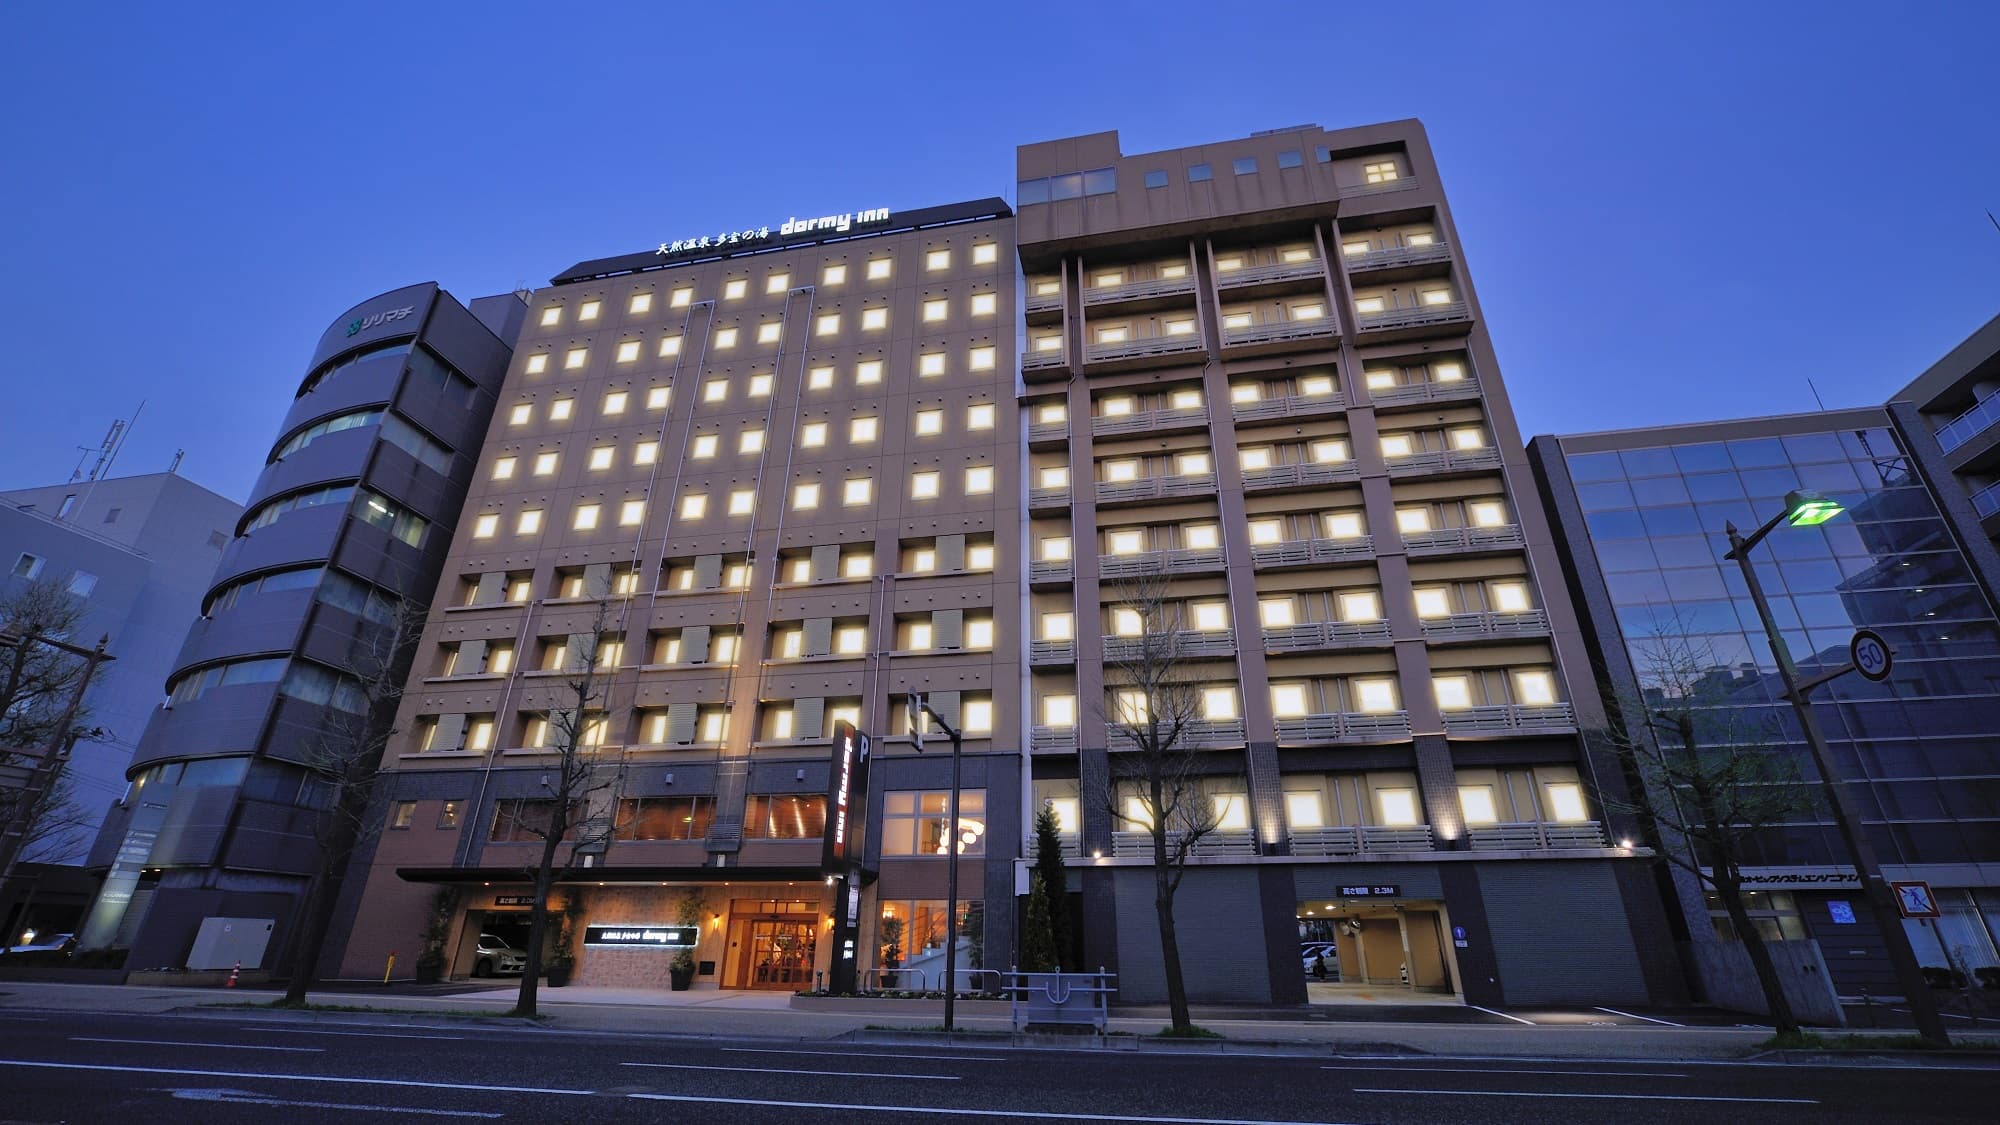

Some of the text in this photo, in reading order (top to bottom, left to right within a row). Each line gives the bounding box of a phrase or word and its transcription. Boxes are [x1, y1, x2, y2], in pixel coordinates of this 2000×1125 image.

[780, 208, 889, 235] dormy inn
[655, 226, 769, 255] 天然温泉 多宝の湯
[1858, 642, 1884, 669] 50
[860, 735, 869, 763] P
